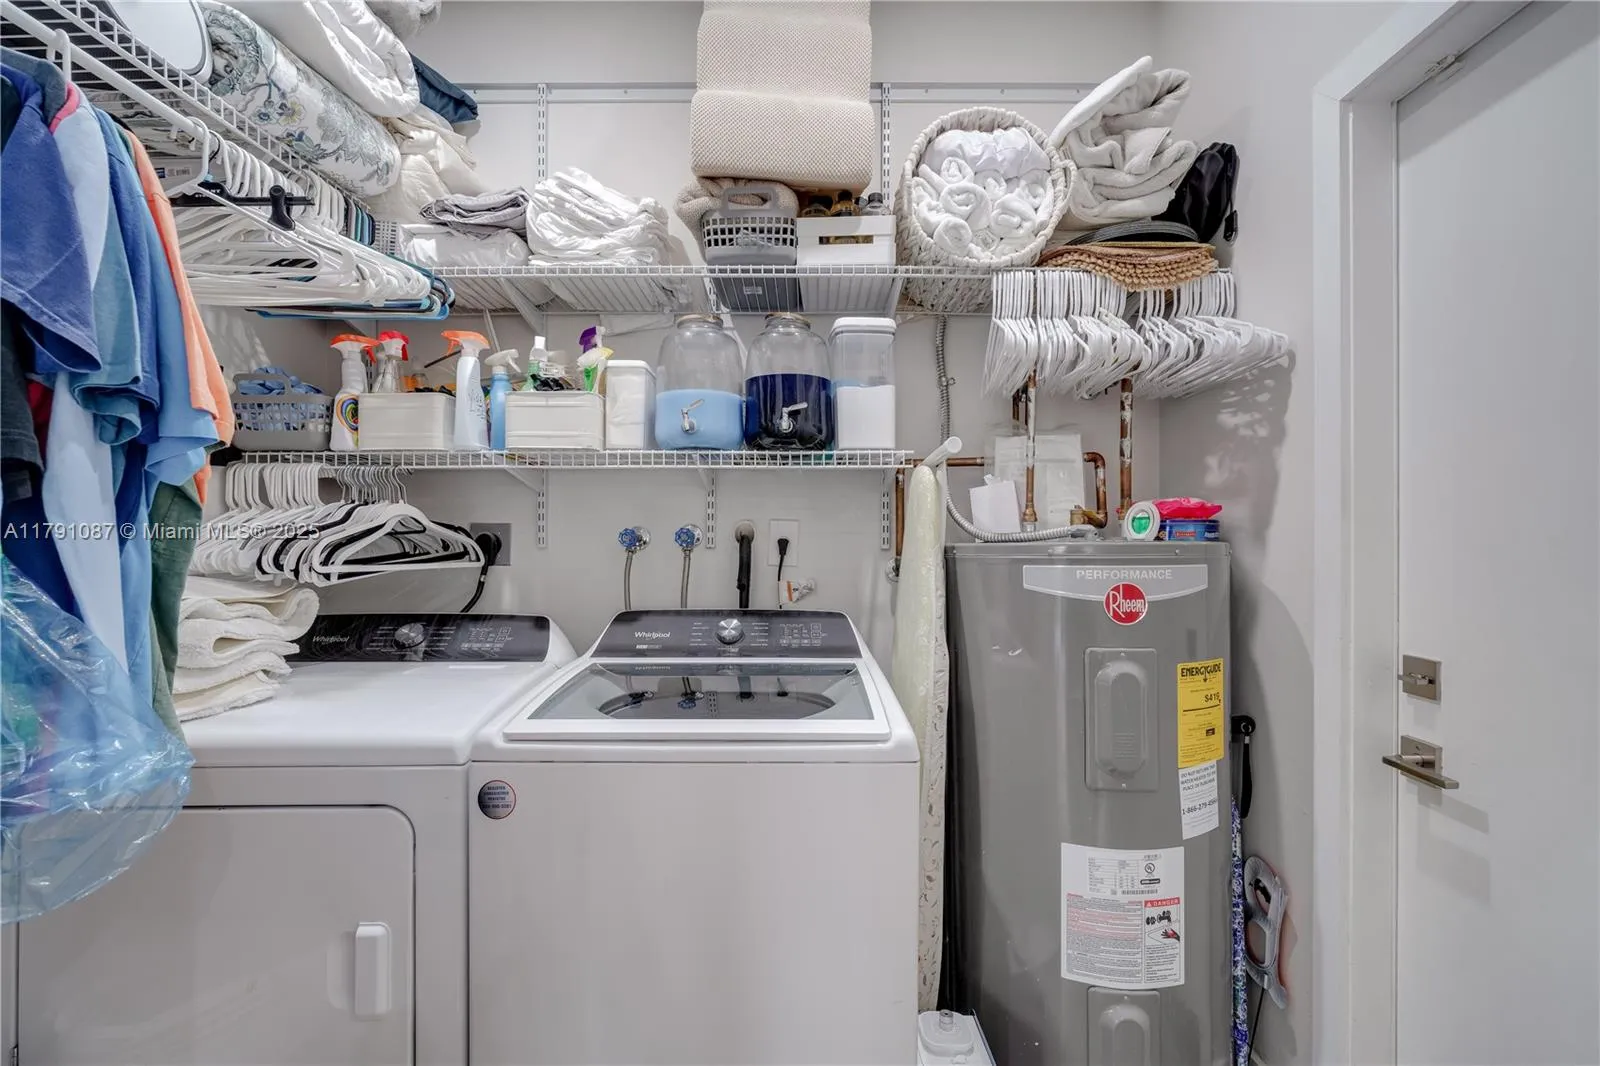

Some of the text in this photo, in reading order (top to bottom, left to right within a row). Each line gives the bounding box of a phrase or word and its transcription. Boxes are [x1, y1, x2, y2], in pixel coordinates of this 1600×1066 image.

[1075, 569, 1173, 580] PERFORMANCE
[1109, 583, 1145, 618] Rheem
[312, 635, 350, 644] Whirlpool
[634, 631, 671, 640] Whirlpool
[1153, 898, 1179, 906] DANGER
